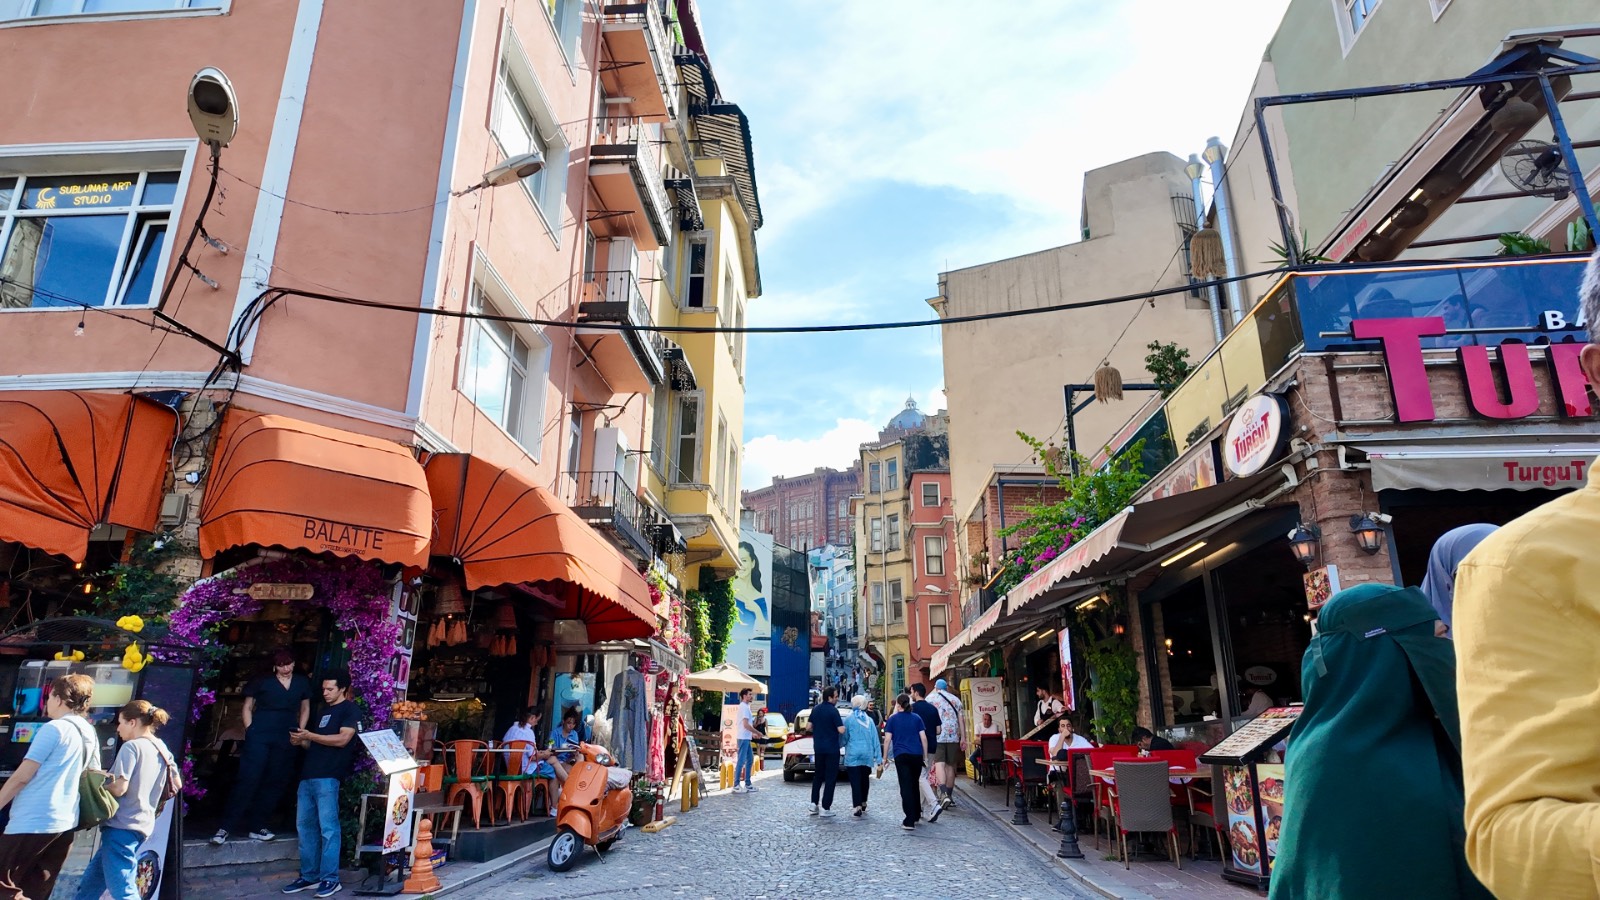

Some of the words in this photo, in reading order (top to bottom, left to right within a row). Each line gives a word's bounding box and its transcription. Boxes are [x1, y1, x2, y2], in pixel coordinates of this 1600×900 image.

[59, 183, 108, 195] SUBLUNAR
[112, 181, 132, 191] ART
[73, 194, 111, 206] STUDIO
[1232, 411, 1271, 463] TURGUT
[1503, 460, 1586, 486] TurguT
[304, 519, 384, 550] BALATTE
